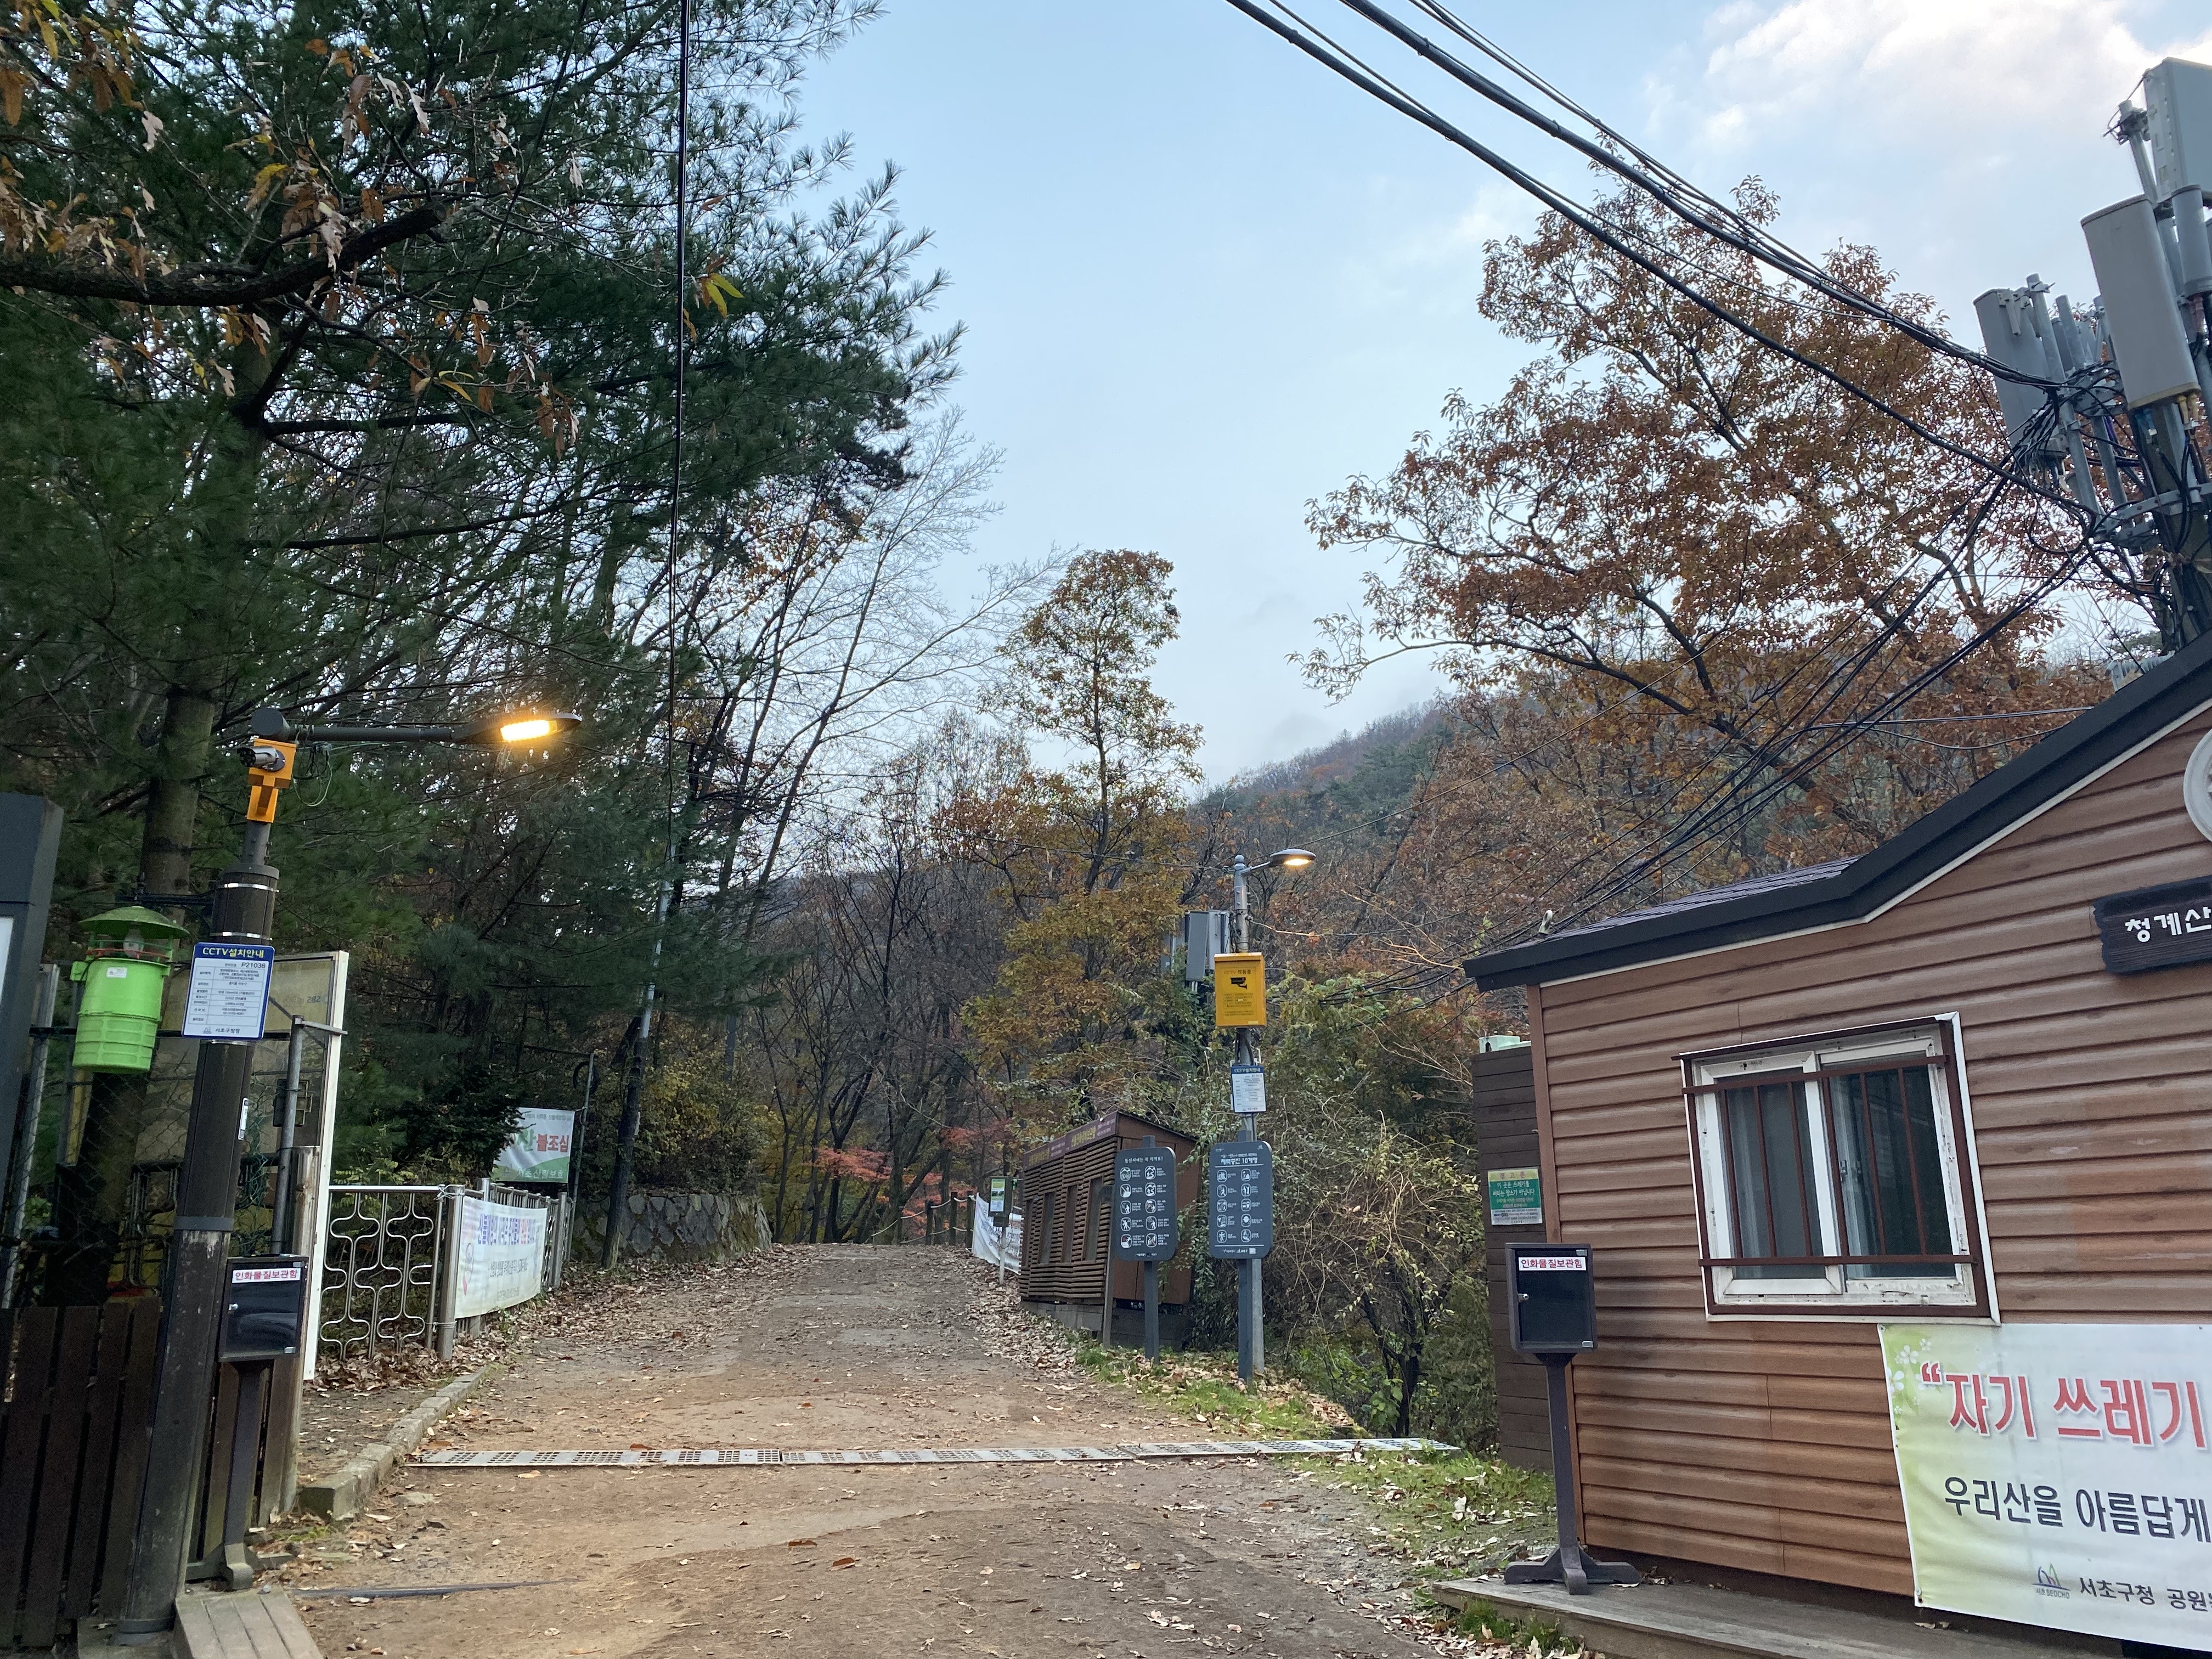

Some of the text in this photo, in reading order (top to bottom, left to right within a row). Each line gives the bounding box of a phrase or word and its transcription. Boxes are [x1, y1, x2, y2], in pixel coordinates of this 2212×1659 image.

[2125, 906, 2212, 943] 청계산
[202, 947, 264, 958] CCTV설치안내
[235, 1269, 298, 1280] 인화물질보관함
[1521, 1259, 1582, 1268] 인화물질보관함
[2052, 1377, 2207, 1450] 쓰레기
[1944, 1476, 2212, 1544] 우리산을 아름답게
[2046, 1590, 2070, 1600] SEOCHO
[2079, 1577, 2212, 1612] 서초구청 공원
